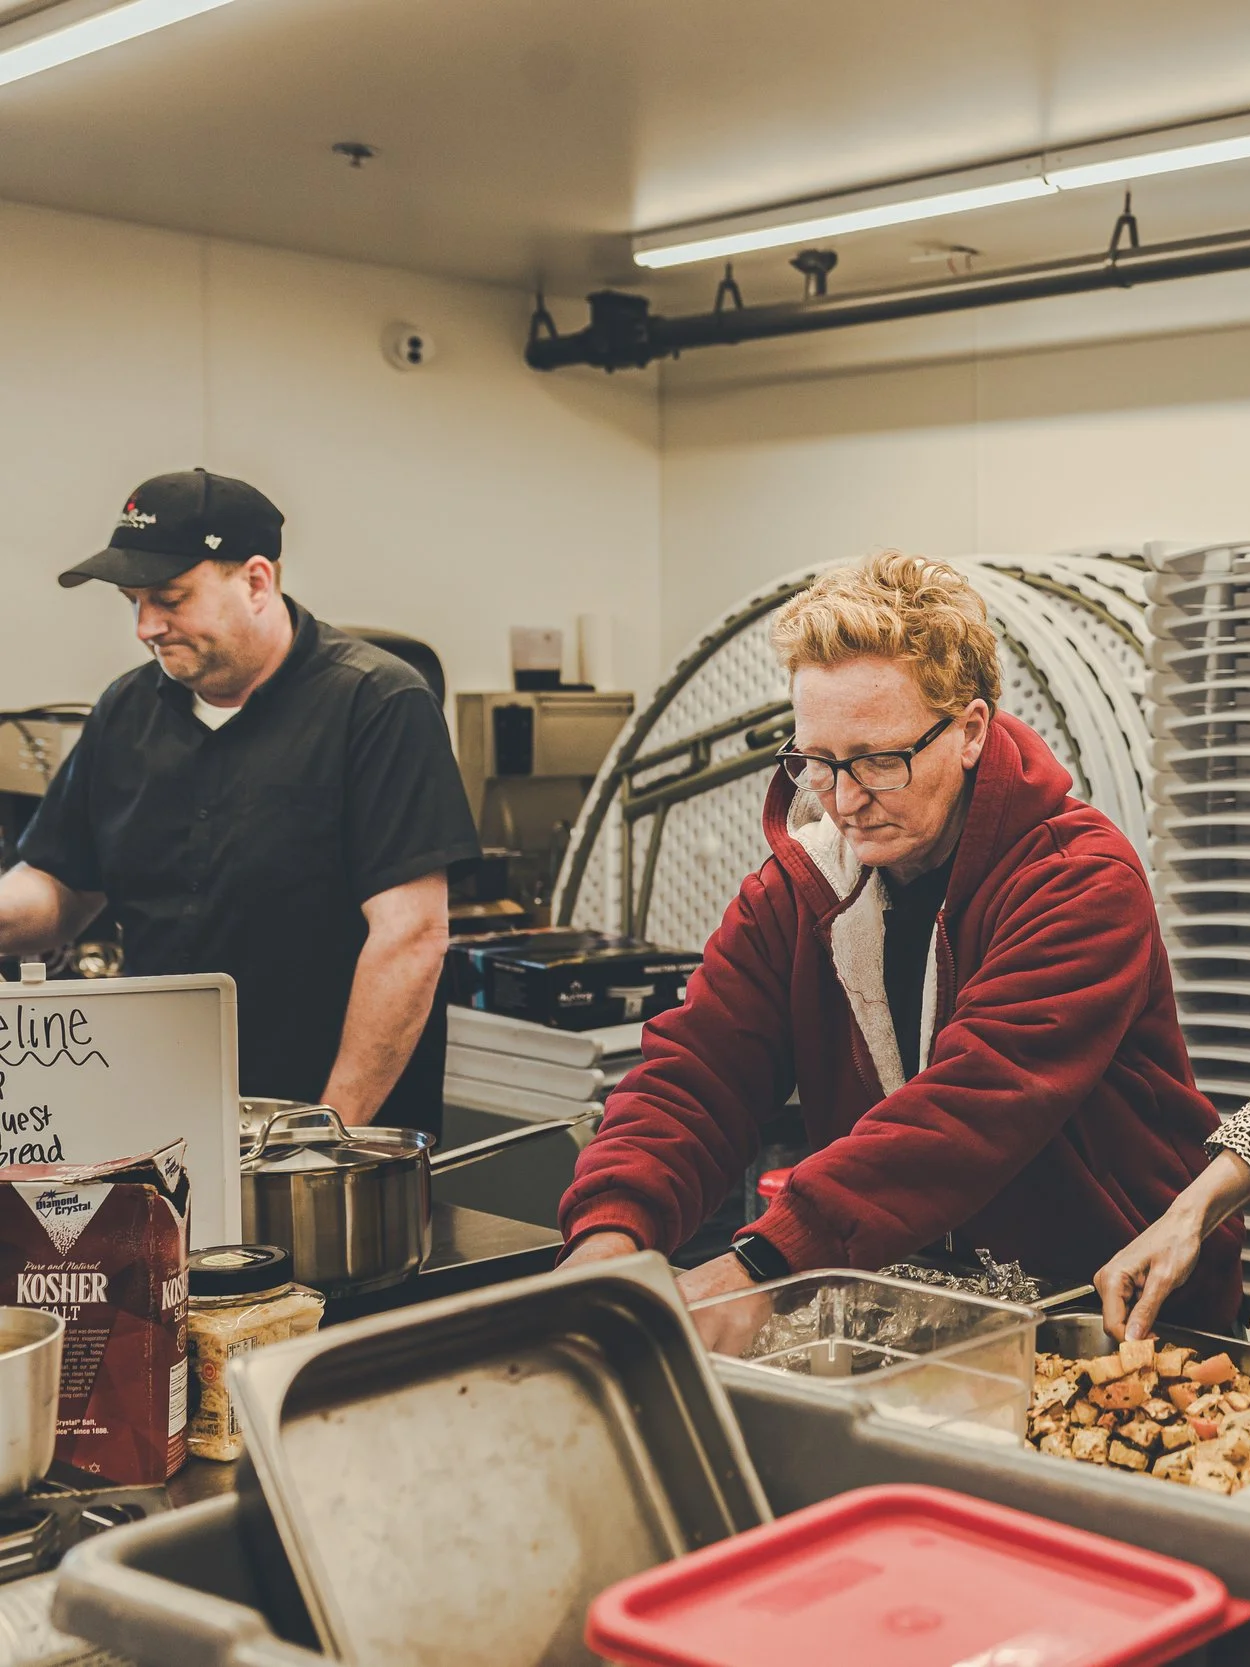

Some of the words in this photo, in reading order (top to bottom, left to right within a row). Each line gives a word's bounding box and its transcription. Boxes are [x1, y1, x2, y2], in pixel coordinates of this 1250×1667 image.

[36, 1194, 79, 1211] Diamond
[24, 1261, 46, 1271] Pure
[47, 1261, 66, 1270] and
[66, 1261, 101, 1271] Natural
[17, 1273, 108, 1303] KOSHER
